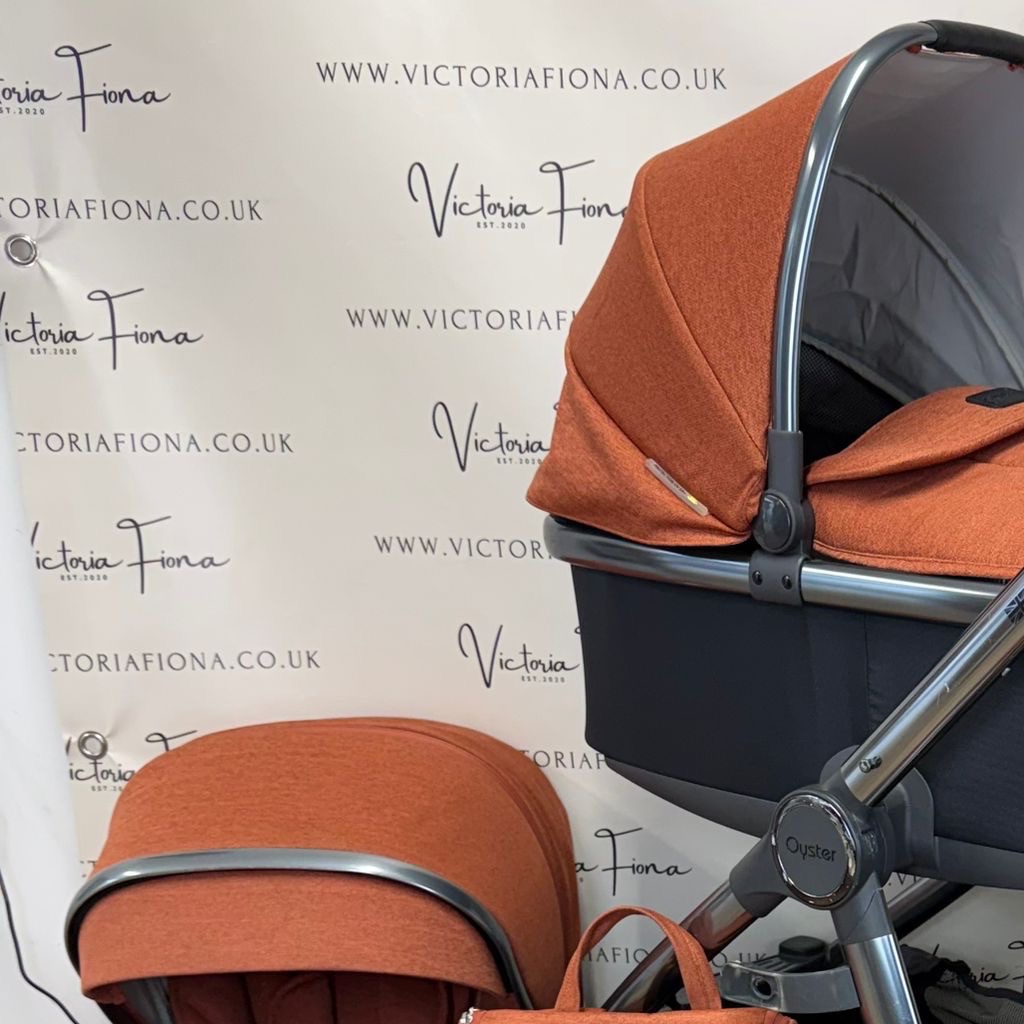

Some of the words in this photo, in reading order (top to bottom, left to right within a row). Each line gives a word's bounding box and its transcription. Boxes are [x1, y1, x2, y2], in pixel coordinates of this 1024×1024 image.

[0, 79, 62, 104] oria
[54, 43, 171, 132] Fiona
[316, 62, 727, 90] WWW.VICTORIAFIONA.CO.UK
[0, 197, 263, 221] ORIAFIONA.CO.UK
[407, 162, 543, 238] Victoria
[0, 291, 94, 346] ictoria
[87, 288, 204, 370] Fiona
[346, 308, 577, 331] WWW.VICTORIAF
[431, 401, 551, 472] Victoria
[117, 516, 231, 594] Fiona
[374, 535, 551, 560] WWW.VICTOR
[458, 623, 580, 688] Victoria
[594, 827, 692, 896] Fiona
[785, 836, 837, 862] Oyster
